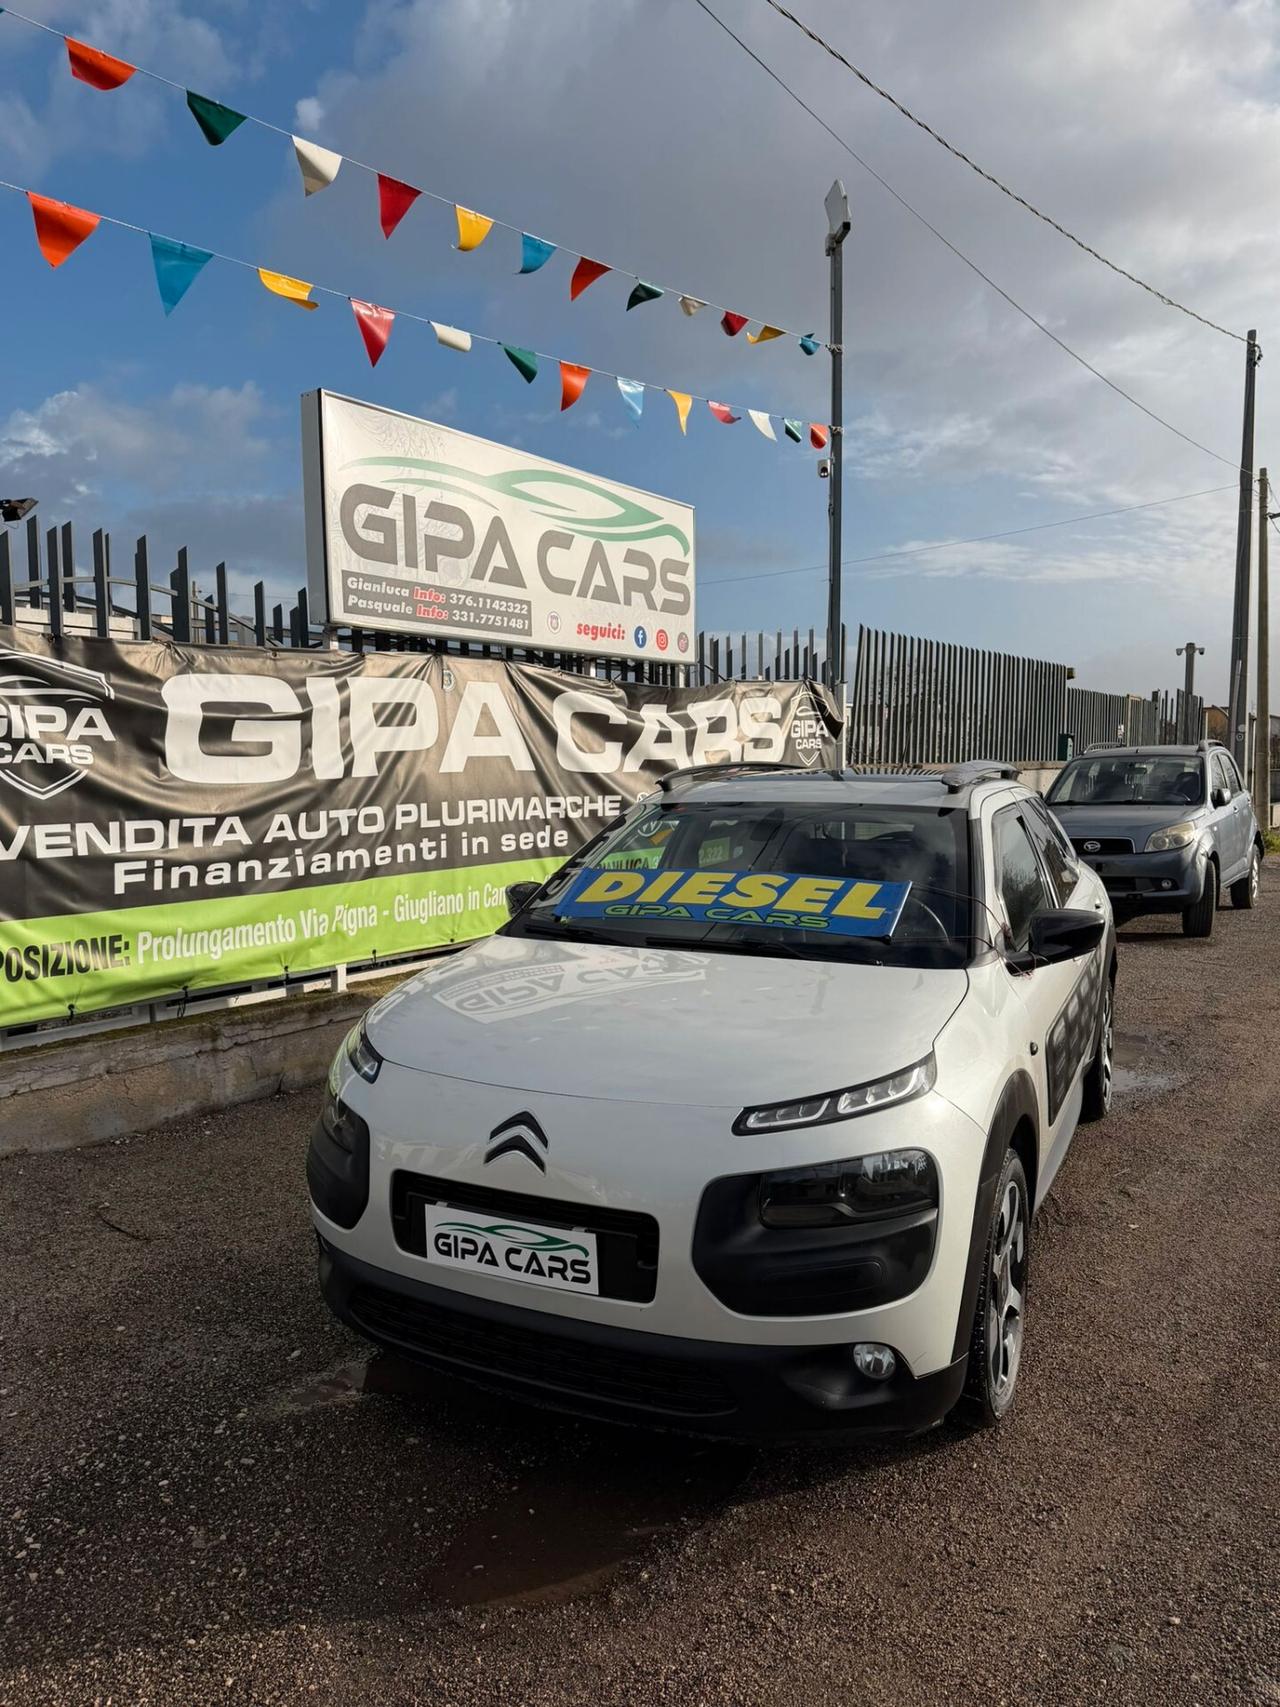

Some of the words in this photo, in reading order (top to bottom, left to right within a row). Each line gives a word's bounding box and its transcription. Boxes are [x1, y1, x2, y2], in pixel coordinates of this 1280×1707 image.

[339, 483, 527, 590] GIPA
[537, 529, 691, 616] CARS
[347, 577, 410, 597] Gianluca
[413, 586, 446, 604] Info:
[450, 593, 528, 614] 376.1142322
[348, 595, 413, 614] Pasquale
[416, 604, 449, 620] Info:
[452, 610, 529, 630] 331.7751481
[576, 622, 625, 640] seguici:
[0, 704, 116, 741] IPA
[161, 673, 536, 784] GIPA
[552, 691, 785, 775] CARS
[791, 720, 829, 738] GIPA
[796, 739, 822, 749] CARS
[0, 816, 252, 861] VENDITA
[263, 806, 385, 843] AUTO
[395, 795, 622, 830] PLURIMARCHE
[114, 833, 447, 895] Finanziamenti
[461, 831, 489, 856] in
[501, 825, 569, 852] sede
[575, 871, 887, 919] DIESEL
[0, 934, 131, 983] OSIZIONE:
[137, 915, 296, 964] Prolungamento
[299, 908, 329, 940] Via
[331, 902, 378, 937] Pigna
[394, 889, 464, 925] Giugliano
[468, 888, 480, 911] in
[604, 904, 692, 918] GIPA
[703, 908, 829, 929] CARS
[434, 1232, 499, 1267] GIPA
[505, 1247, 591, 1285] CARS
